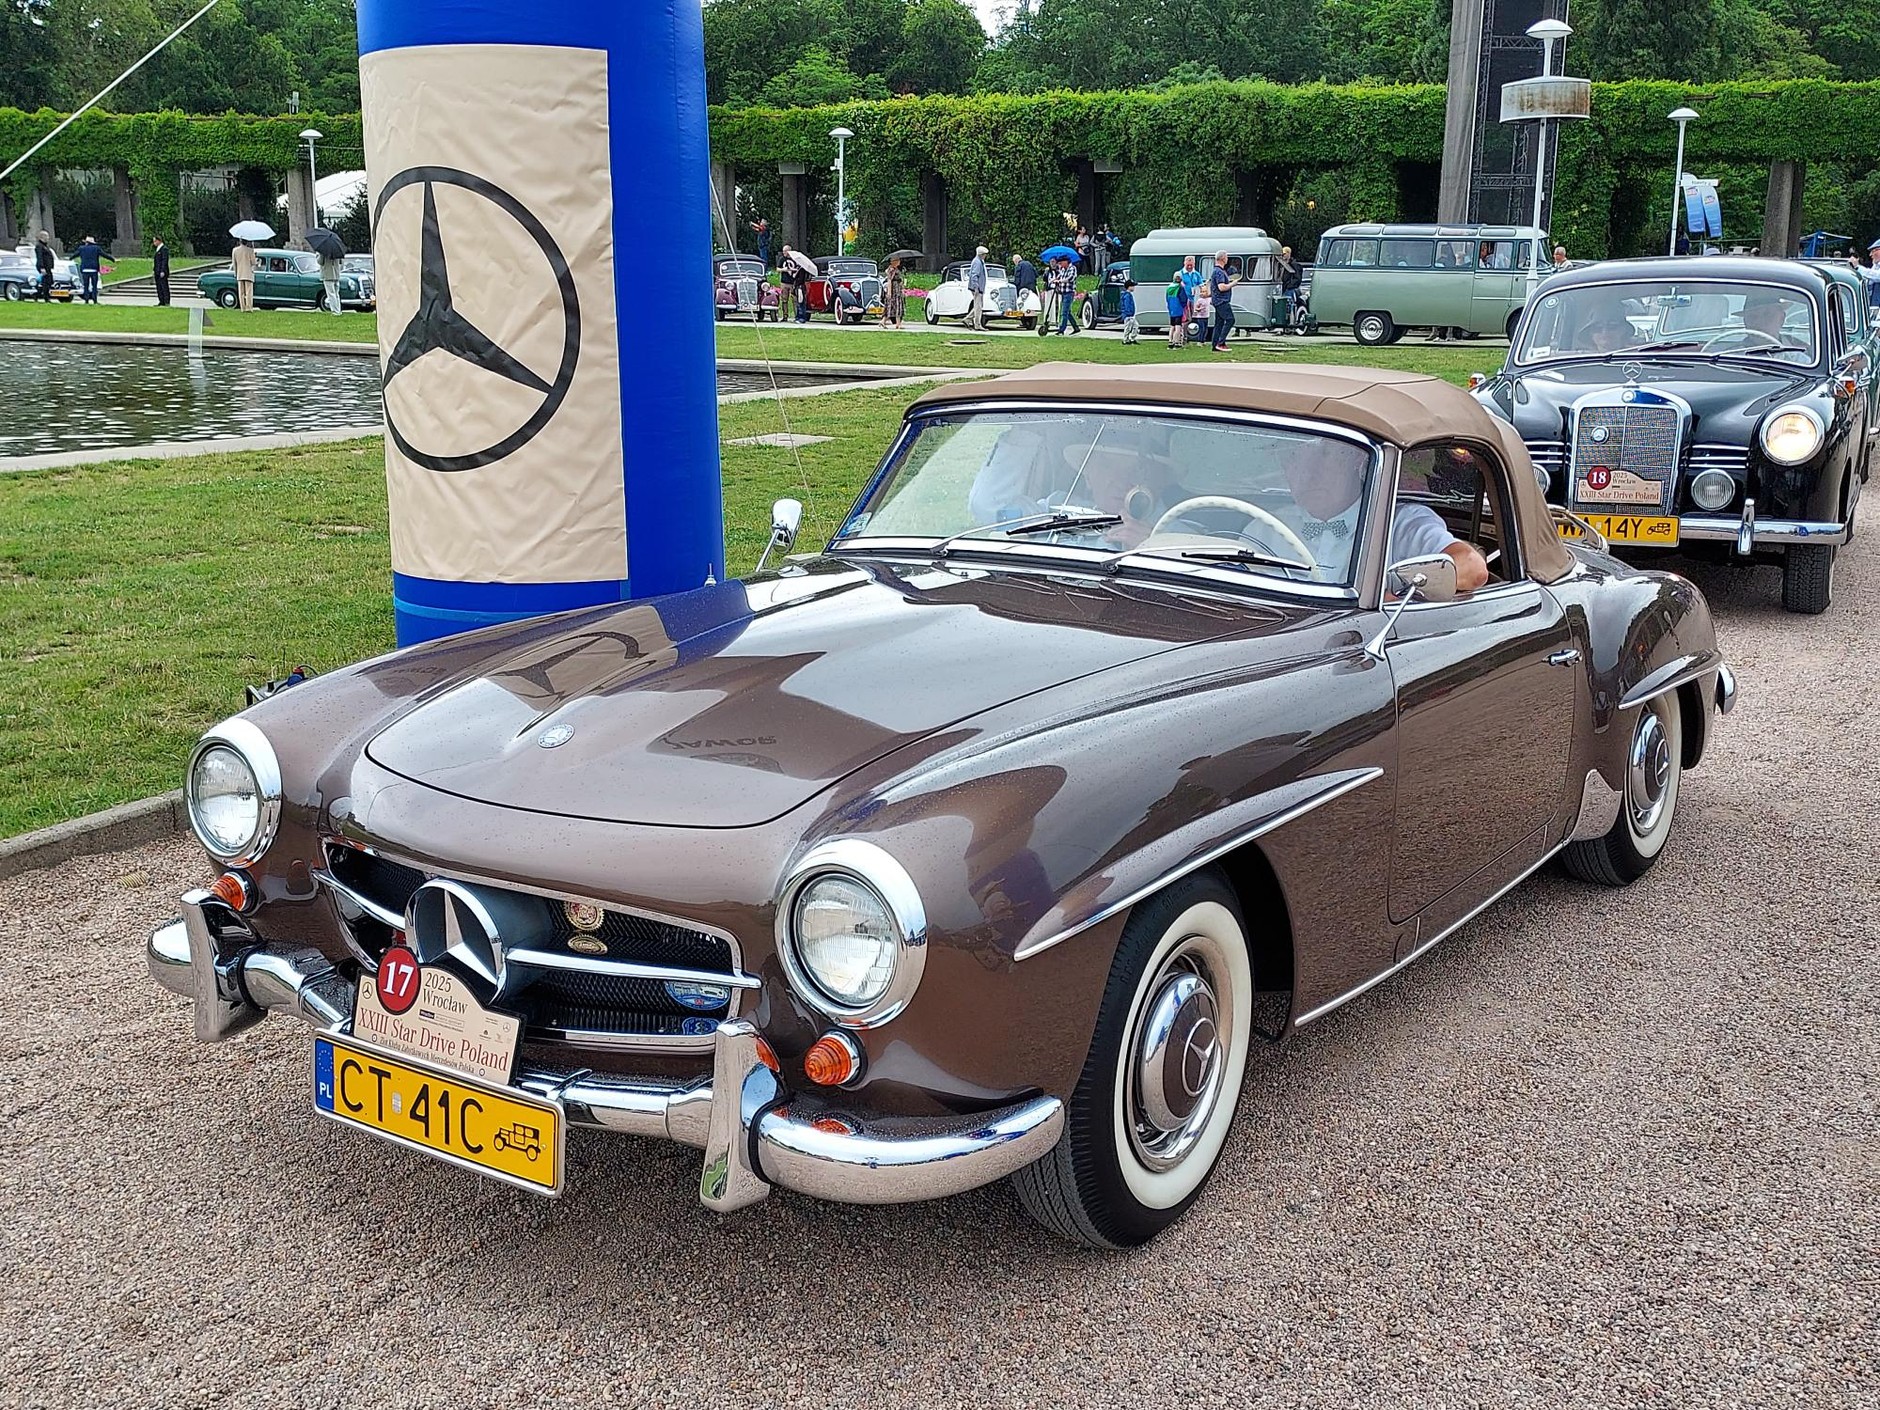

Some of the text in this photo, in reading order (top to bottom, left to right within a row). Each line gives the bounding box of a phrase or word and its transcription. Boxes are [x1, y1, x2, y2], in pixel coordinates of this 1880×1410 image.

[1591, 471, 1607, 484] 18
[1597, 490, 1612, 498] Star
[1613, 491, 1634, 499] Drive
[1635, 491, 1659, 500] Poland
[1604, 517, 1643, 538] 14Y
[383, 961, 415, 998] 17
[425, 972, 452, 993] 2025
[422, 989, 468, 1015] Wrocław
[358, 1007, 389, 1036] XXIII
[391, 1018, 417, 1044] Star
[419, 1027, 456, 1056] Drive
[460, 1039, 509, 1071] Poland
[319, 1082, 333, 1099] PL
[340, 1058, 484, 1154] CT 41C
